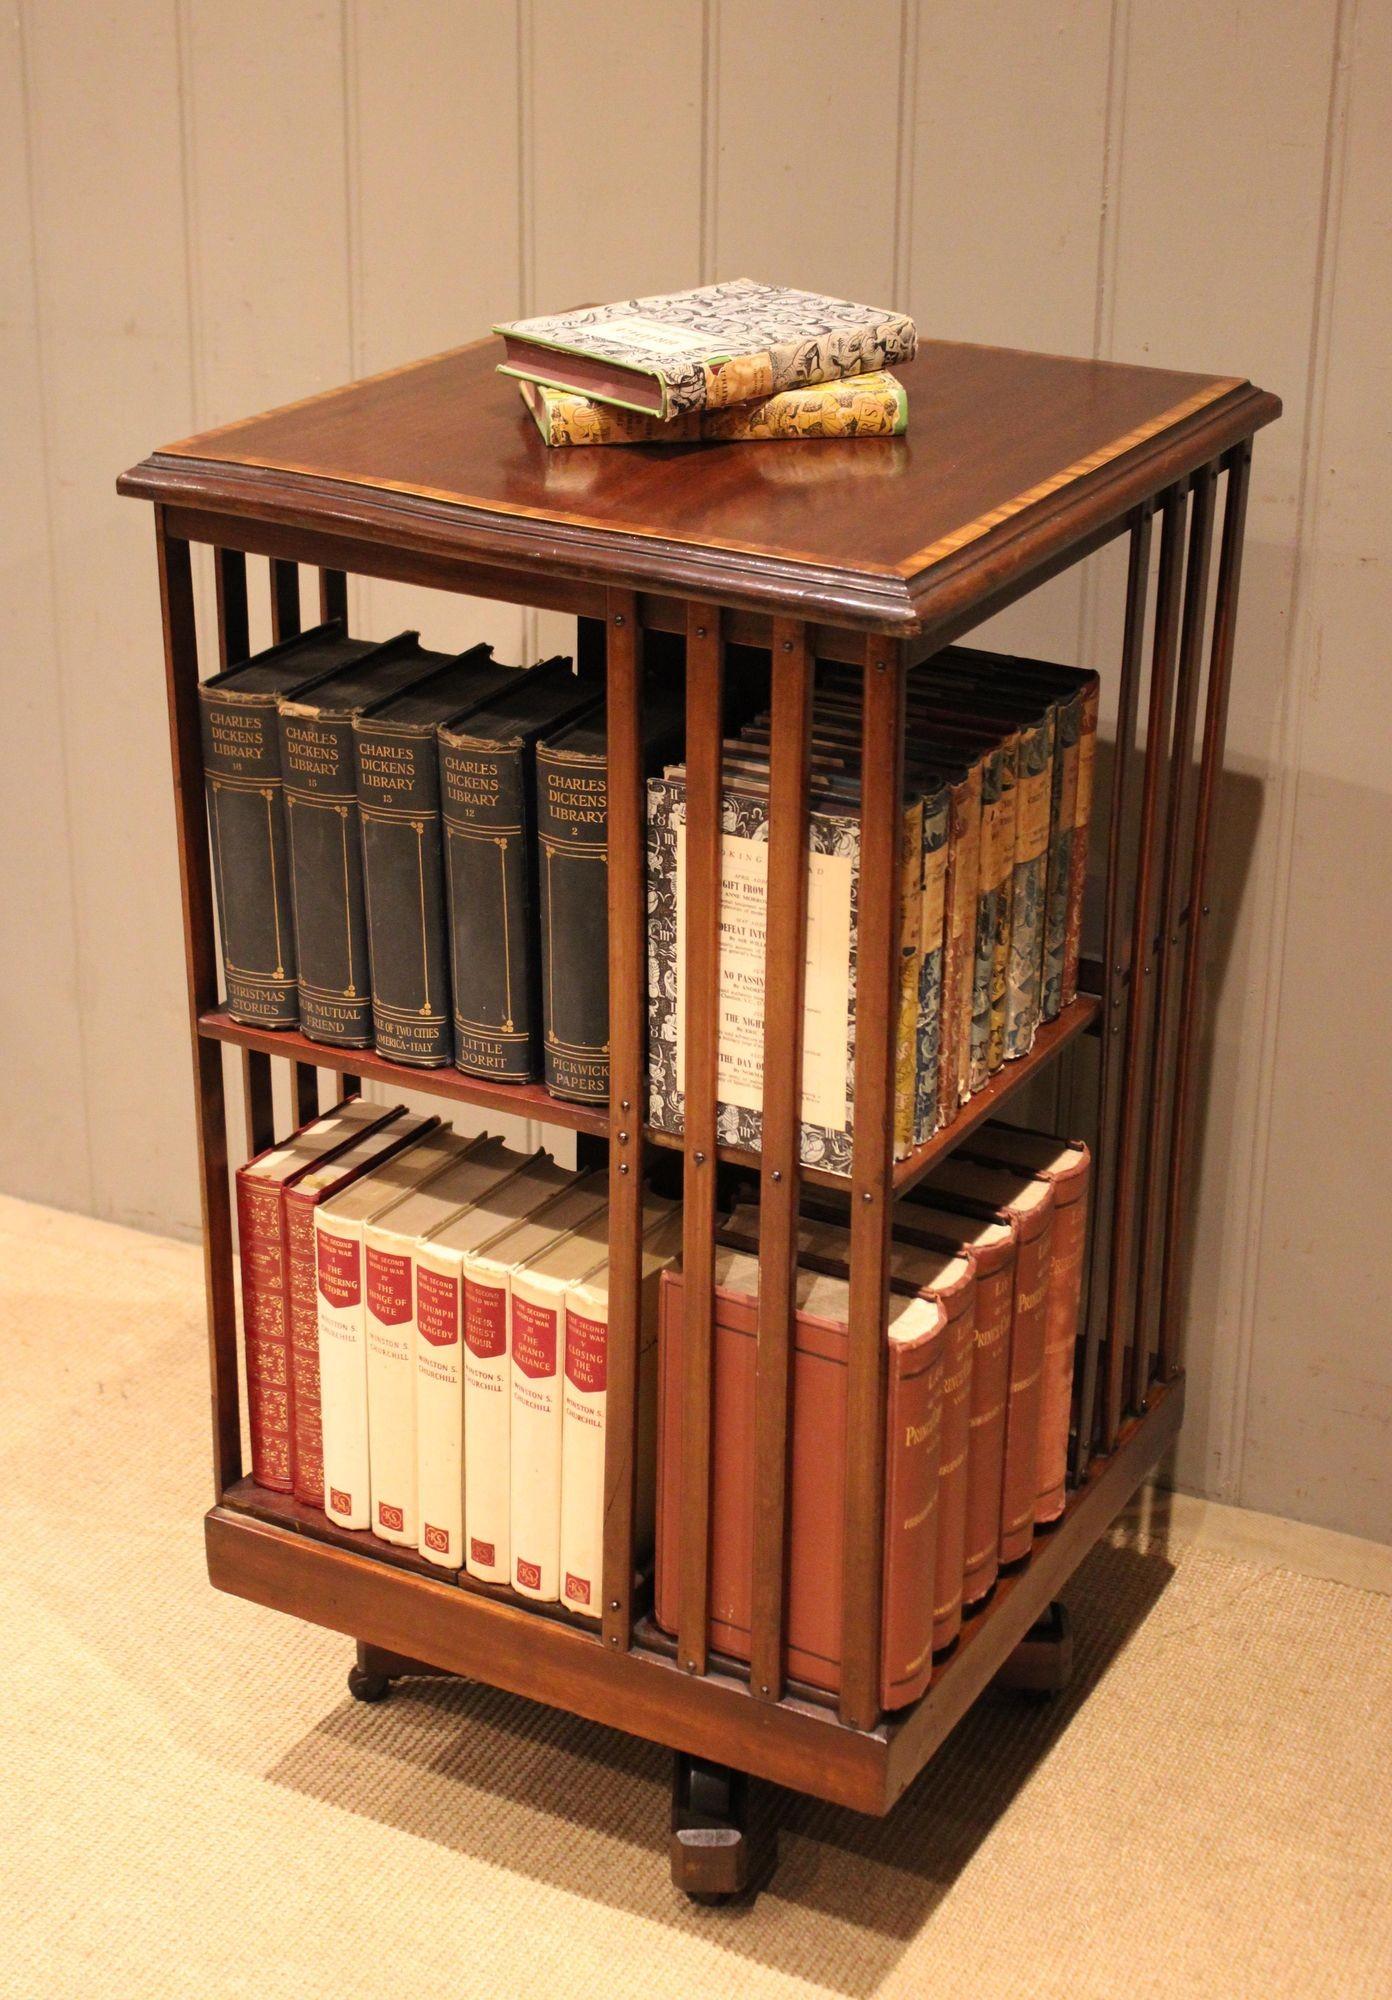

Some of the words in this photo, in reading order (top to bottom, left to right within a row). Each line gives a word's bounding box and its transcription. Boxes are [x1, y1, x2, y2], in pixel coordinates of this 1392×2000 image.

[210, 712, 262, 729] CHARLES
[212, 727, 263, 744] DICKENS
[286, 727, 338, 745] CHARLES
[213, 742, 264, 759] LIBRARY
[288, 742, 339, 760] DICKENS
[359, 743, 414, 760] CHARLES
[289, 757, 340, 776] LIBRARY
[361, 759, 415, 776] DICKENS
[445, 756, 498, 775] CHARLES
[362, 773, 415, 791] LIBRARY
[446, 772, 499, 791] DICKENS
[547, 774, 606, 792] CHARLES
[447, 787, 499, 807] LIBRARY
[549, 789, 607, 808] DICKENS
[465, 808, 475, 817] 12
[550, 805, 608, 824] LIBRARY
[571, 827, 578, 836] 2
[722, 880, 739, 891] GIFT
[743, 883, 764, 896] FROM
[719, 923, 745, 936] DEFEAT
[724, 970, 734, 980] NO
[228, 983, 286, 1002] CHRISTMAS
[233, 999, 279, 1015] STORIES
[315, 1004, 361, 1020] MUTUAL
[307, 1015, 345, 1033] FRIEND
[726, 1013, 739, 1024] THE
[385, 1022, 394, 1033] OF
[396, 1025, 412, 1037] TWO
[413, 1028, 440, 1039] CITIES
[462, 1036, 503, 1055] LITTLE
[462, 1050, 507, 1069] DORRIT
[552, 1057, 610, 1077] PICKWICK
[720, 1054, 733, 1064] THE
[737, 1058, 751, 1068] DAY
[556, 1072, 605, 1092] PAPERS
[327, 1264, 343, 1276] THE
[389, 1268, 405, 1276] WAR
[324, 1283, 349, 1297] STORM
[376, 1282, 394, 1295] THE
[369, 1288, 392, 1305] HINGE
[395, 1298, 407, 1307] OF
[376, 1303, 397, 1316] FATE
[419, 1299, 454, 1319] TRIUMPH
[321, 1315, 348, 1331] WINSTON
[426, 1315, 443, 1326] AND
[535, 1319, 550, 1328] WAR
[321, 1325, 357, 1342] CHURCHILL
[419, 1320, 453, 1339] TRAGEDY
[369, 1333, 399, 1349] WINSTON
[469, 1334, 492, 1349] HOUR
[522, 1333, 539, 1346] THE
[589, 1334, 605, 1344] WAR
[369, 1343, 409, 1361] CHURCHILL
[519, 1342, 544, 1358] GRAND
[568, 1343, 603, 1364] CLOSING
[418, 1354, 448, 1371] WINSTON
[515, 1349, 551, 1371] ALLIANCE
[575, 1359, 591, 1372] THE
[418, 1365, 457, 1384] CHURCHILL
[465, 1365, 494, 1381] WINSTON
[573, 1368, 594, 1384] RING
[466, 1376, 503, 1392] CHURCHILL
[514, 1382, 543, 1401] WINSTON
[514, 1392, 551, 1413] CHURCHILL
[567, 1397, 595, 1415] WINSTON
[566, 1408, 602, 1428] CHURCHILL
